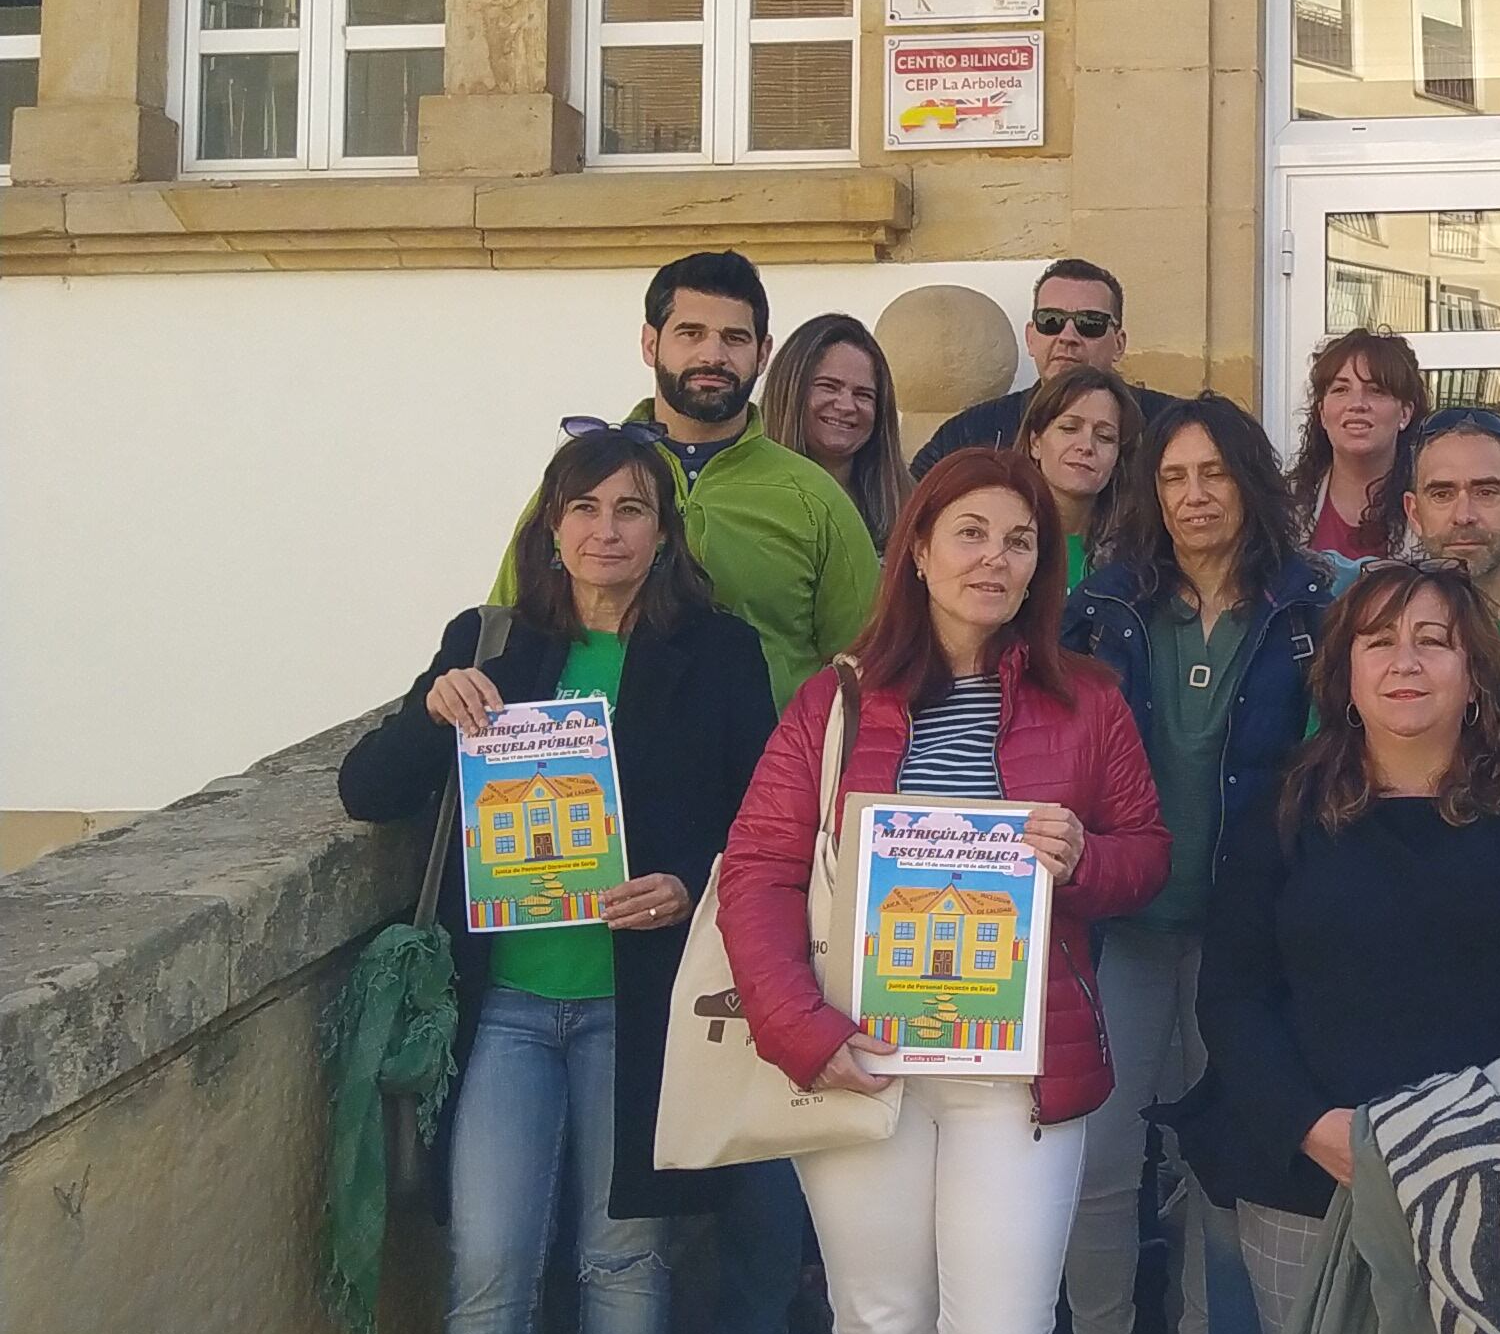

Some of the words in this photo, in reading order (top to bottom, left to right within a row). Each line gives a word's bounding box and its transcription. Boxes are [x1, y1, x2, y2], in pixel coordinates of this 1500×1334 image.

[897, 55, 957, 69] CENTRO
[960, 49, 1030, 67] BILINGÜE
[905, 79, 938, 91] CEIP
[942, 79, 958, 90] La
[961, 75, 1022, 89] Arboleda
[565, 719, 582, 730] EN
[584, 717, 599, 728] LA
[476, 739, 536, 755] ESCUELA
[538, 734, 594, 750] PÚBLICA
[881, 827, 987, 843] MATRICÚLATE
[989, 833, 1010, 843] EN
[888, 847, 954, 859] ESCUELA
[956, 847, 1020, 862] PÚBLICA
[791, 1097, 810, 1107] ERES
